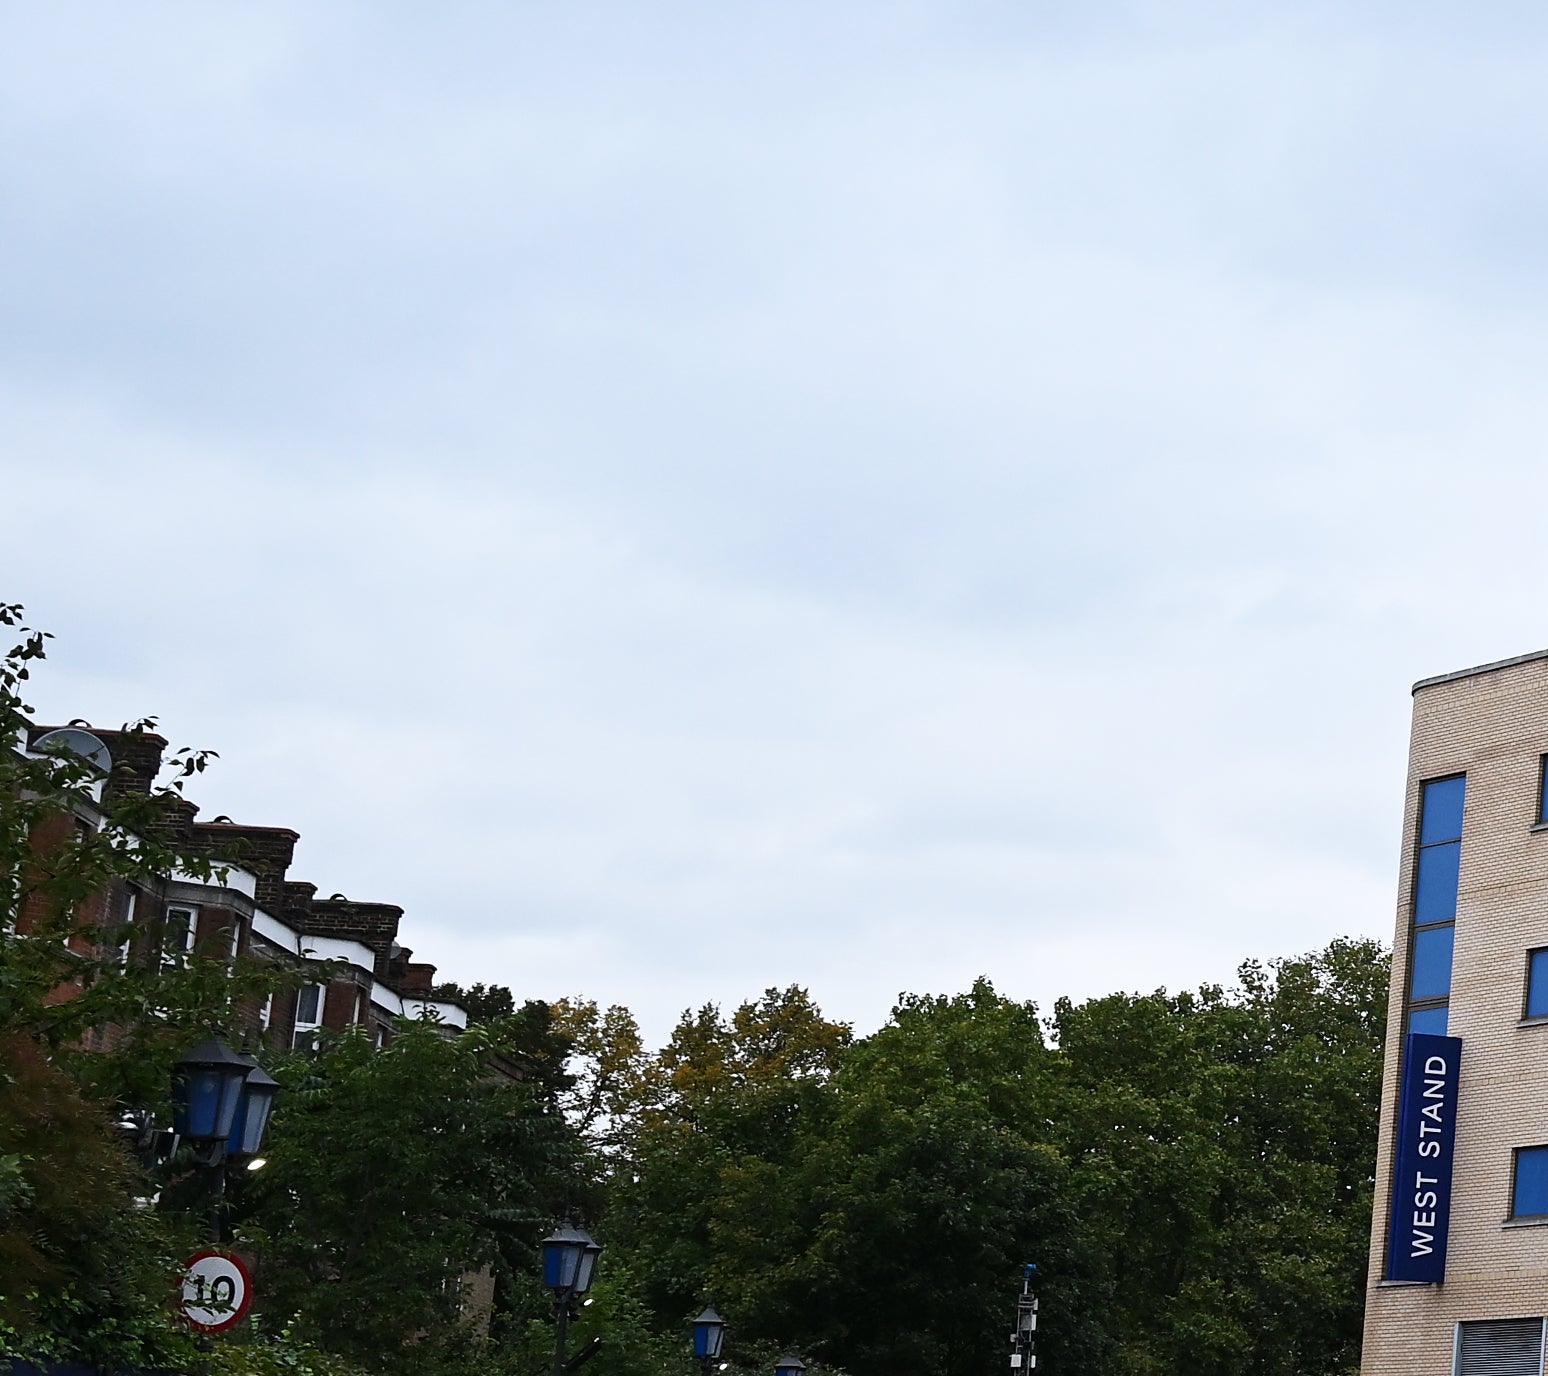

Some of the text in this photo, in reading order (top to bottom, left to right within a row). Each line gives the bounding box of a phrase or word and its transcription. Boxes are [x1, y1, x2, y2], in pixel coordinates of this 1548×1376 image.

[1410, 1055, 1447, 1258] WEST STAND
[194, 1274, 236, 1310] 10
